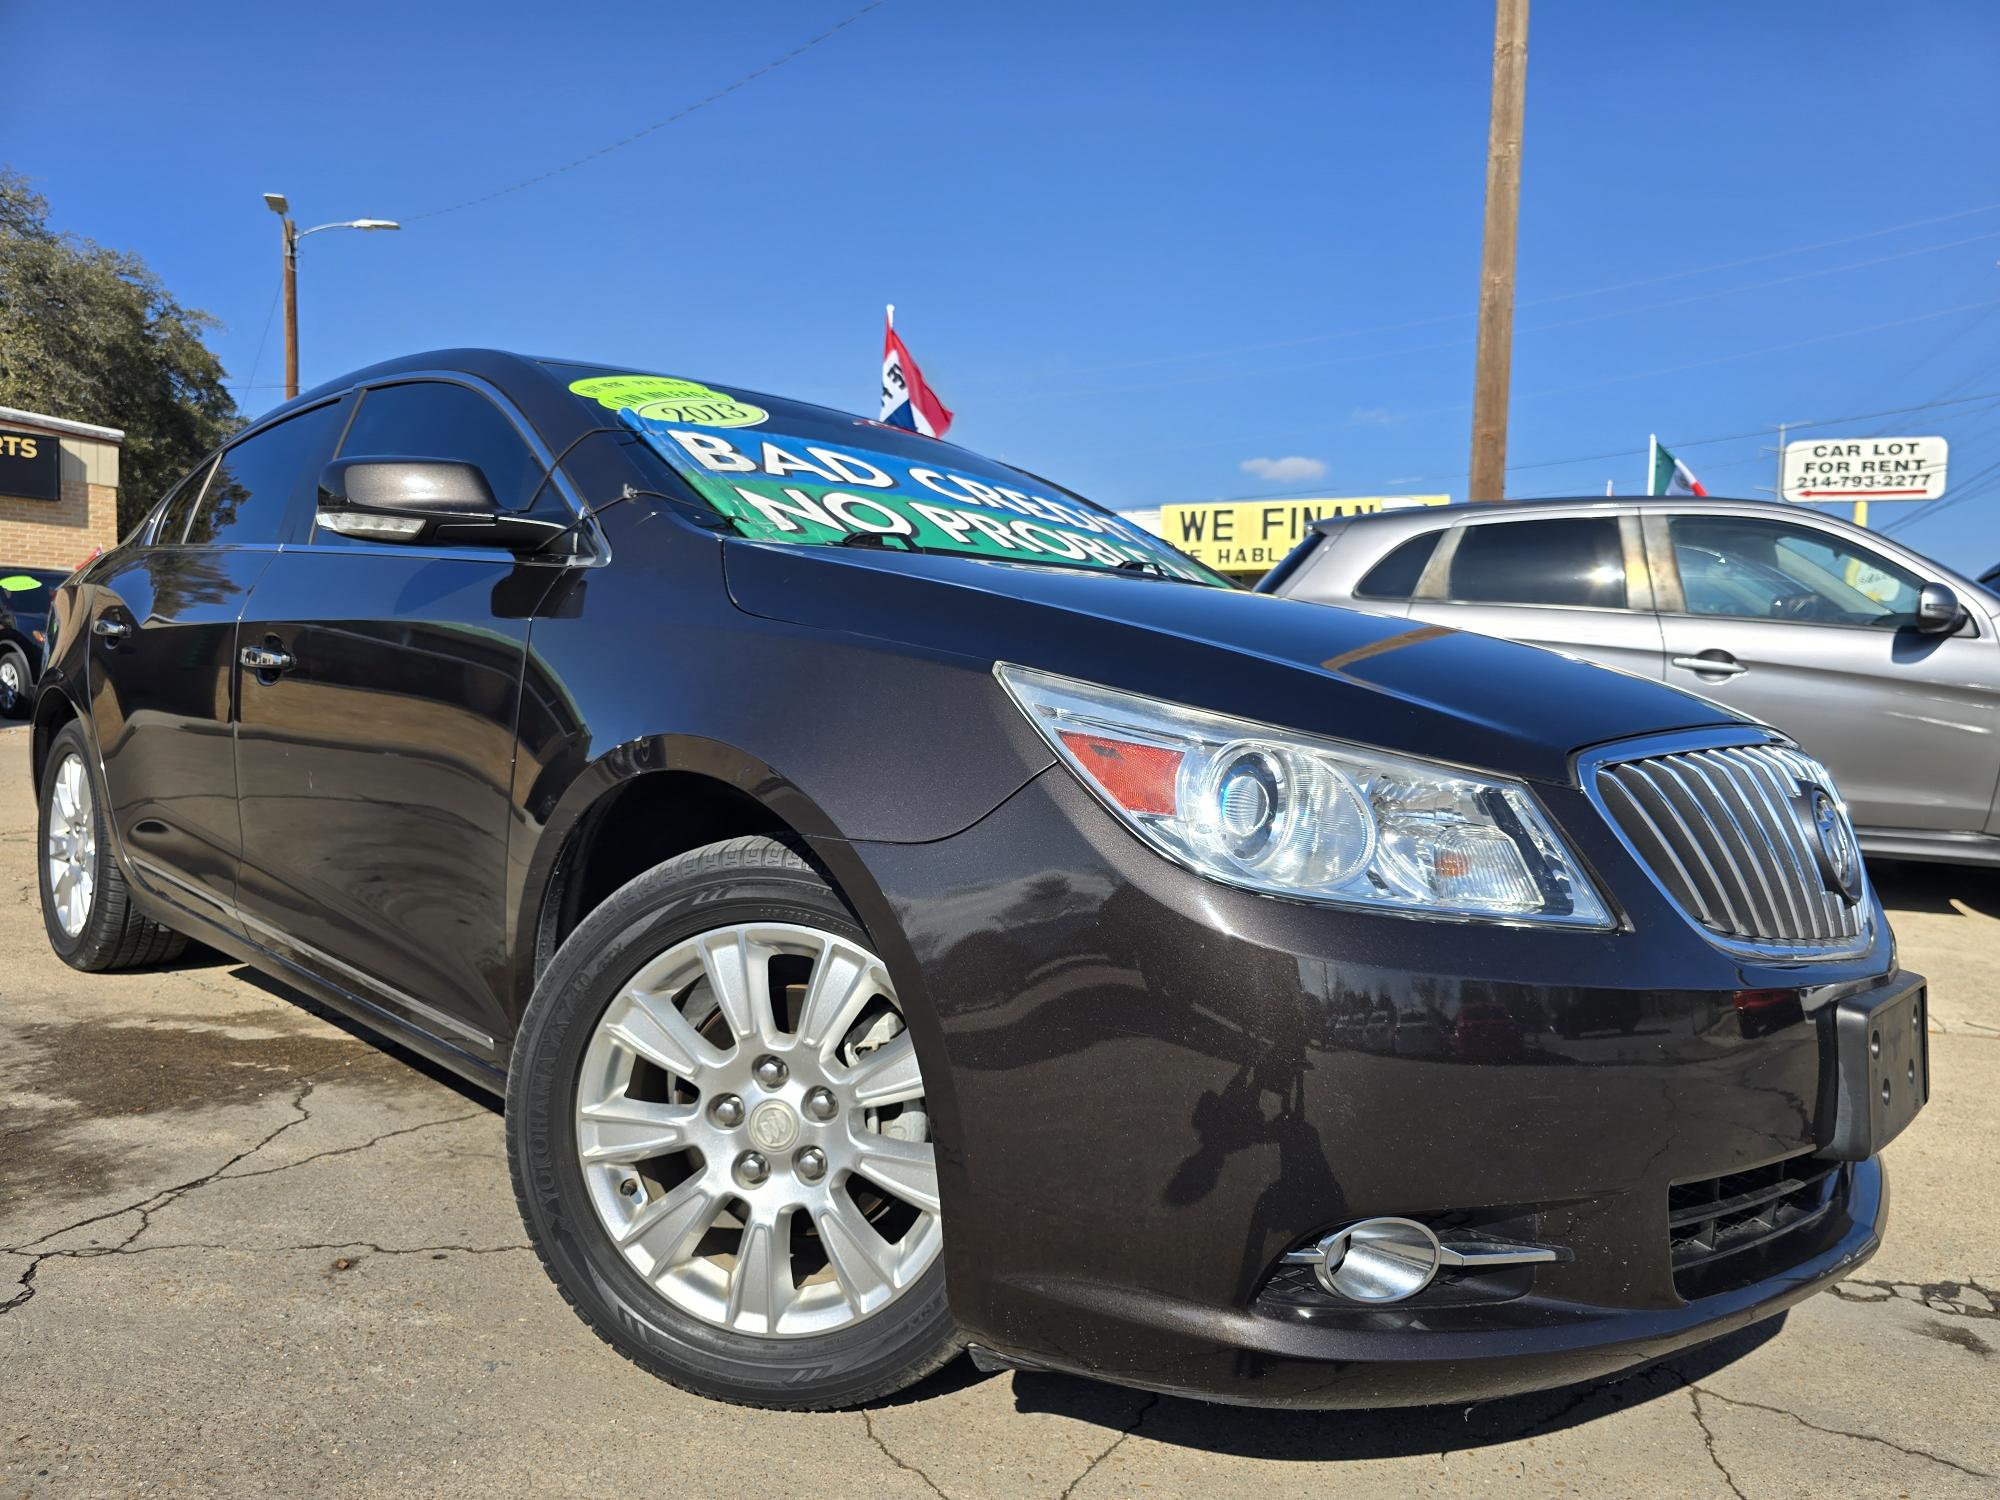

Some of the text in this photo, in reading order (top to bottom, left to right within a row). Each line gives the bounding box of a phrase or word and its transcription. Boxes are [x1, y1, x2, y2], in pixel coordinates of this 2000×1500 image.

[661, 403, 748, 423] 2013
[0, 436, 38, 459] TS
[1813, 442, 1920, 458] CAR LOT
[1804, 459, 1927, 474] FOR RENT
[666, 429, 1154, 550] BAD CREDIT
[1797, 474, 1931, 488] 214-793-2277
[734, 487, 912, 536] NO
[1180, 509, 1233, 542] WE
[1218, 547, 1298, 564] HABL
[528, 1051, 562, 1204] YOKOHAMA
